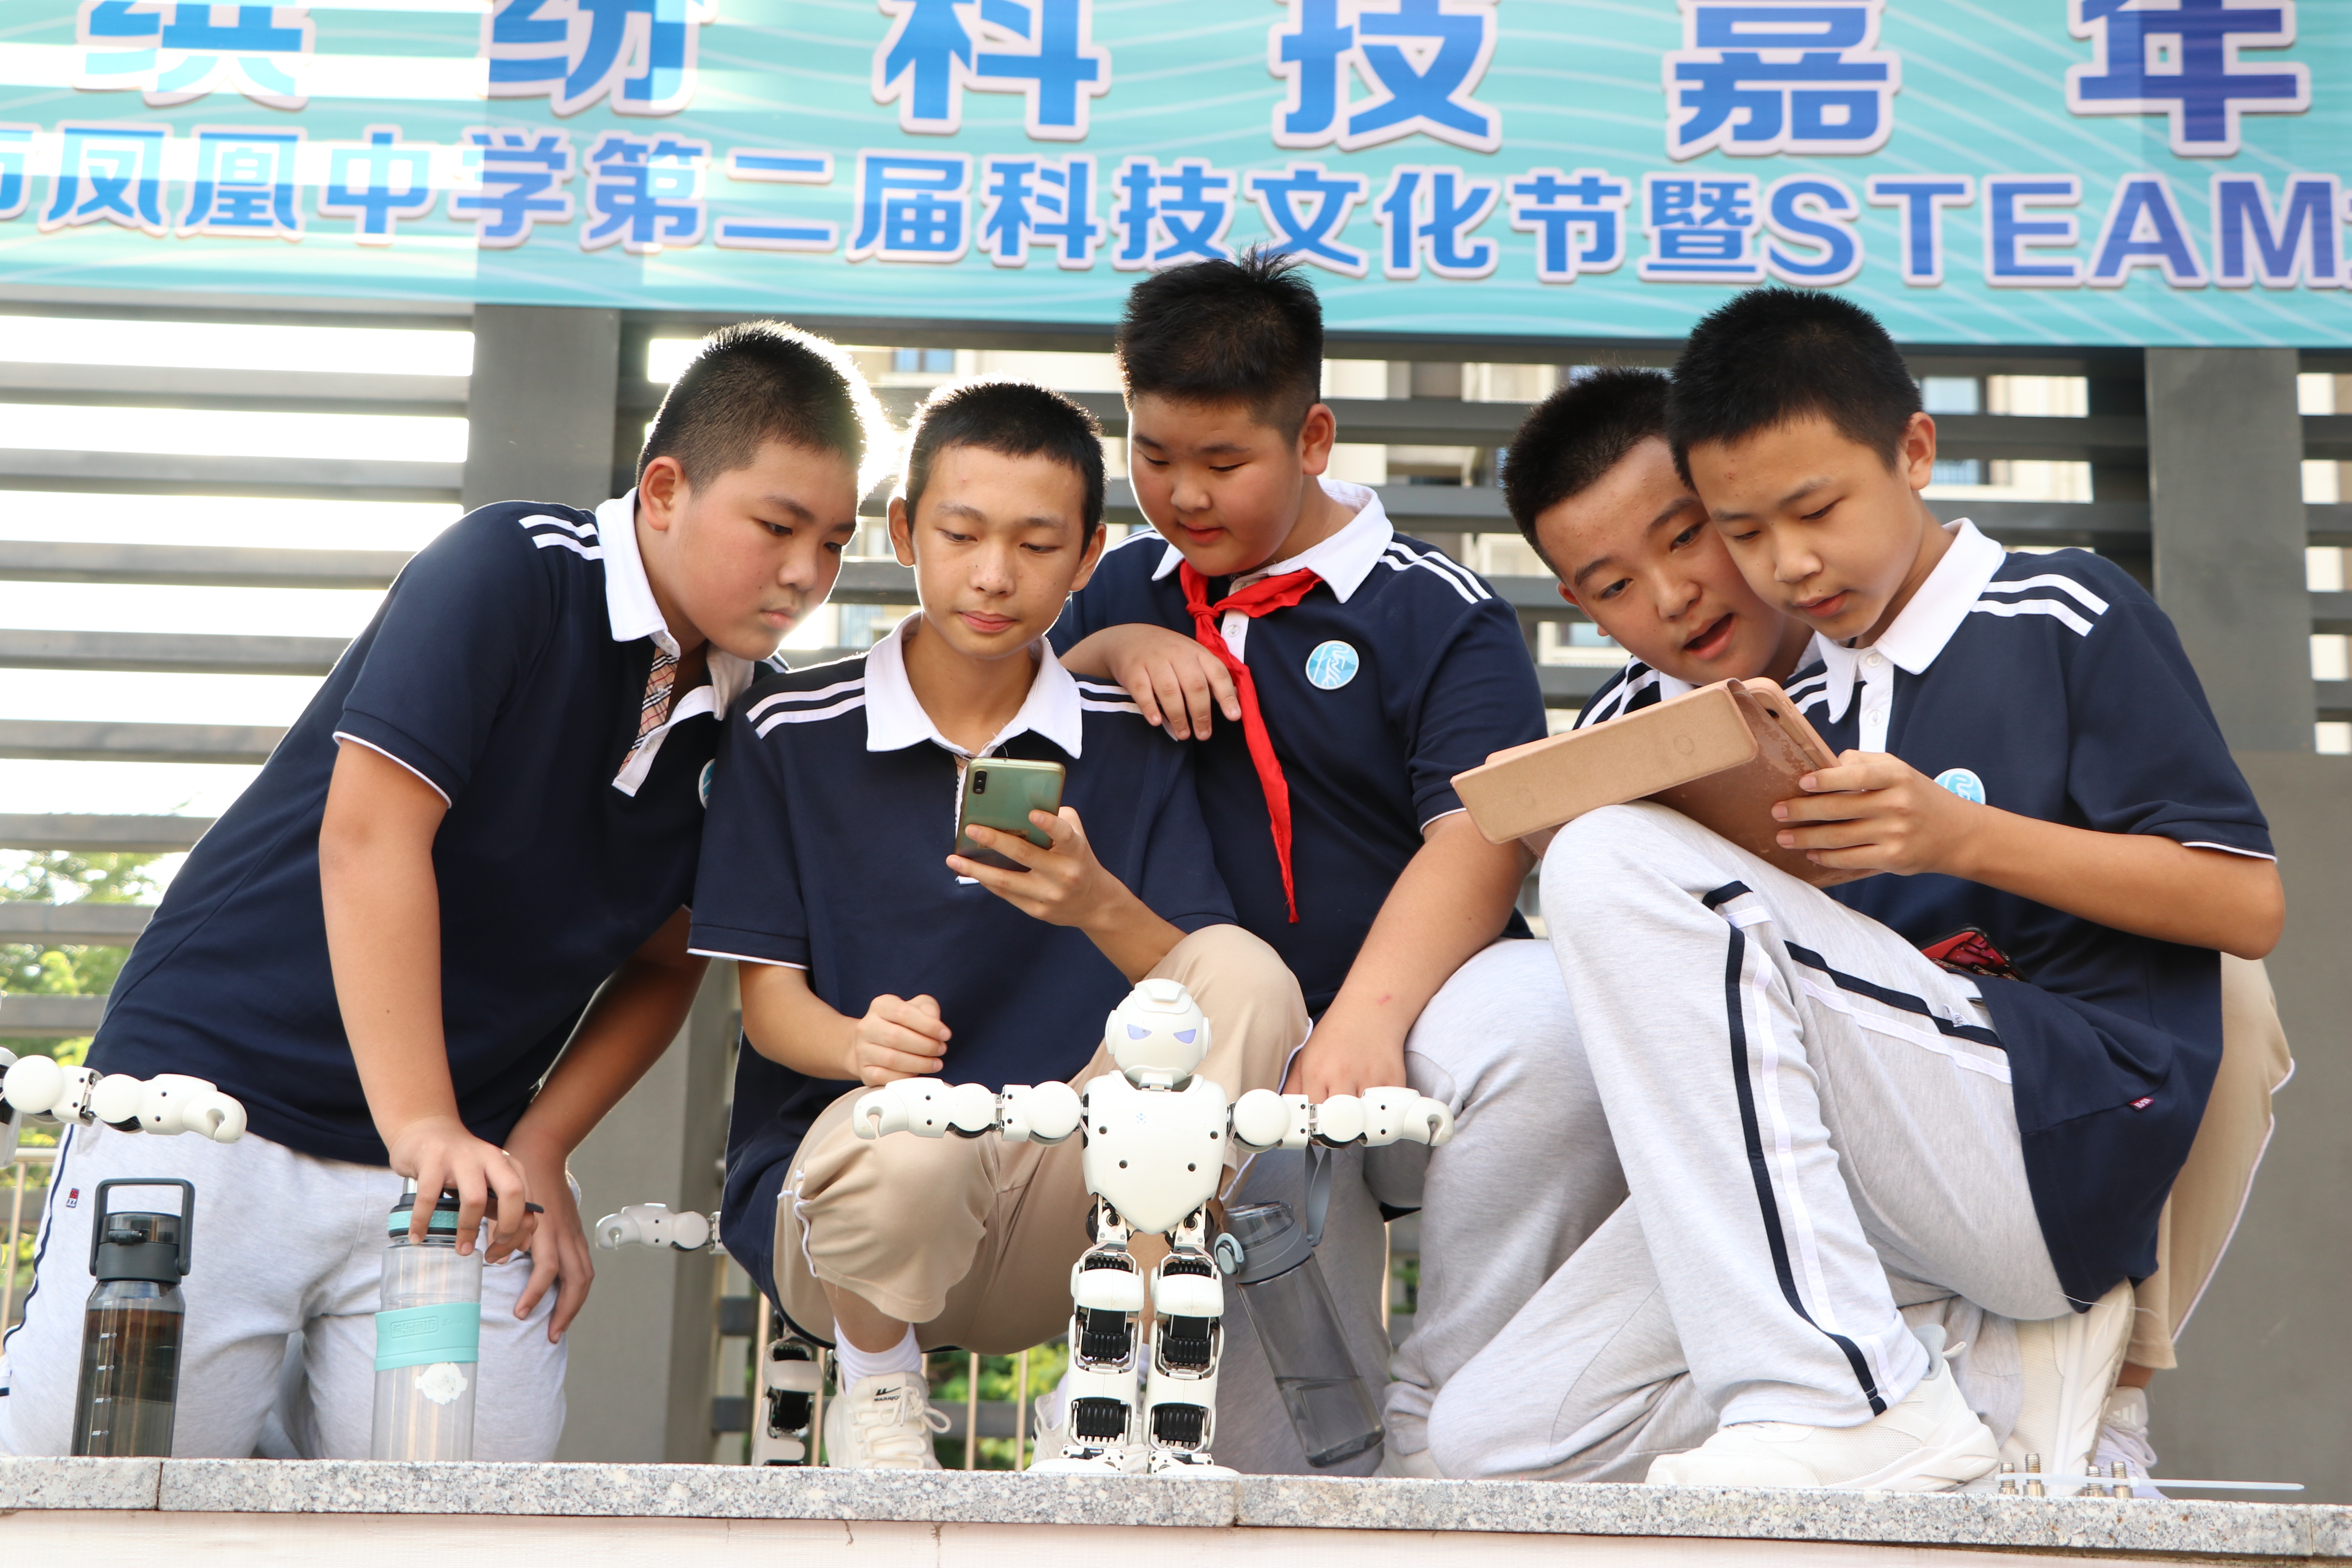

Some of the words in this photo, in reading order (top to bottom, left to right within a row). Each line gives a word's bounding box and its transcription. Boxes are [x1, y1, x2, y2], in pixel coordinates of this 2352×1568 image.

[0, 128, 2352, 279] 凤凰中学第二届科技文化节暨STEAM
